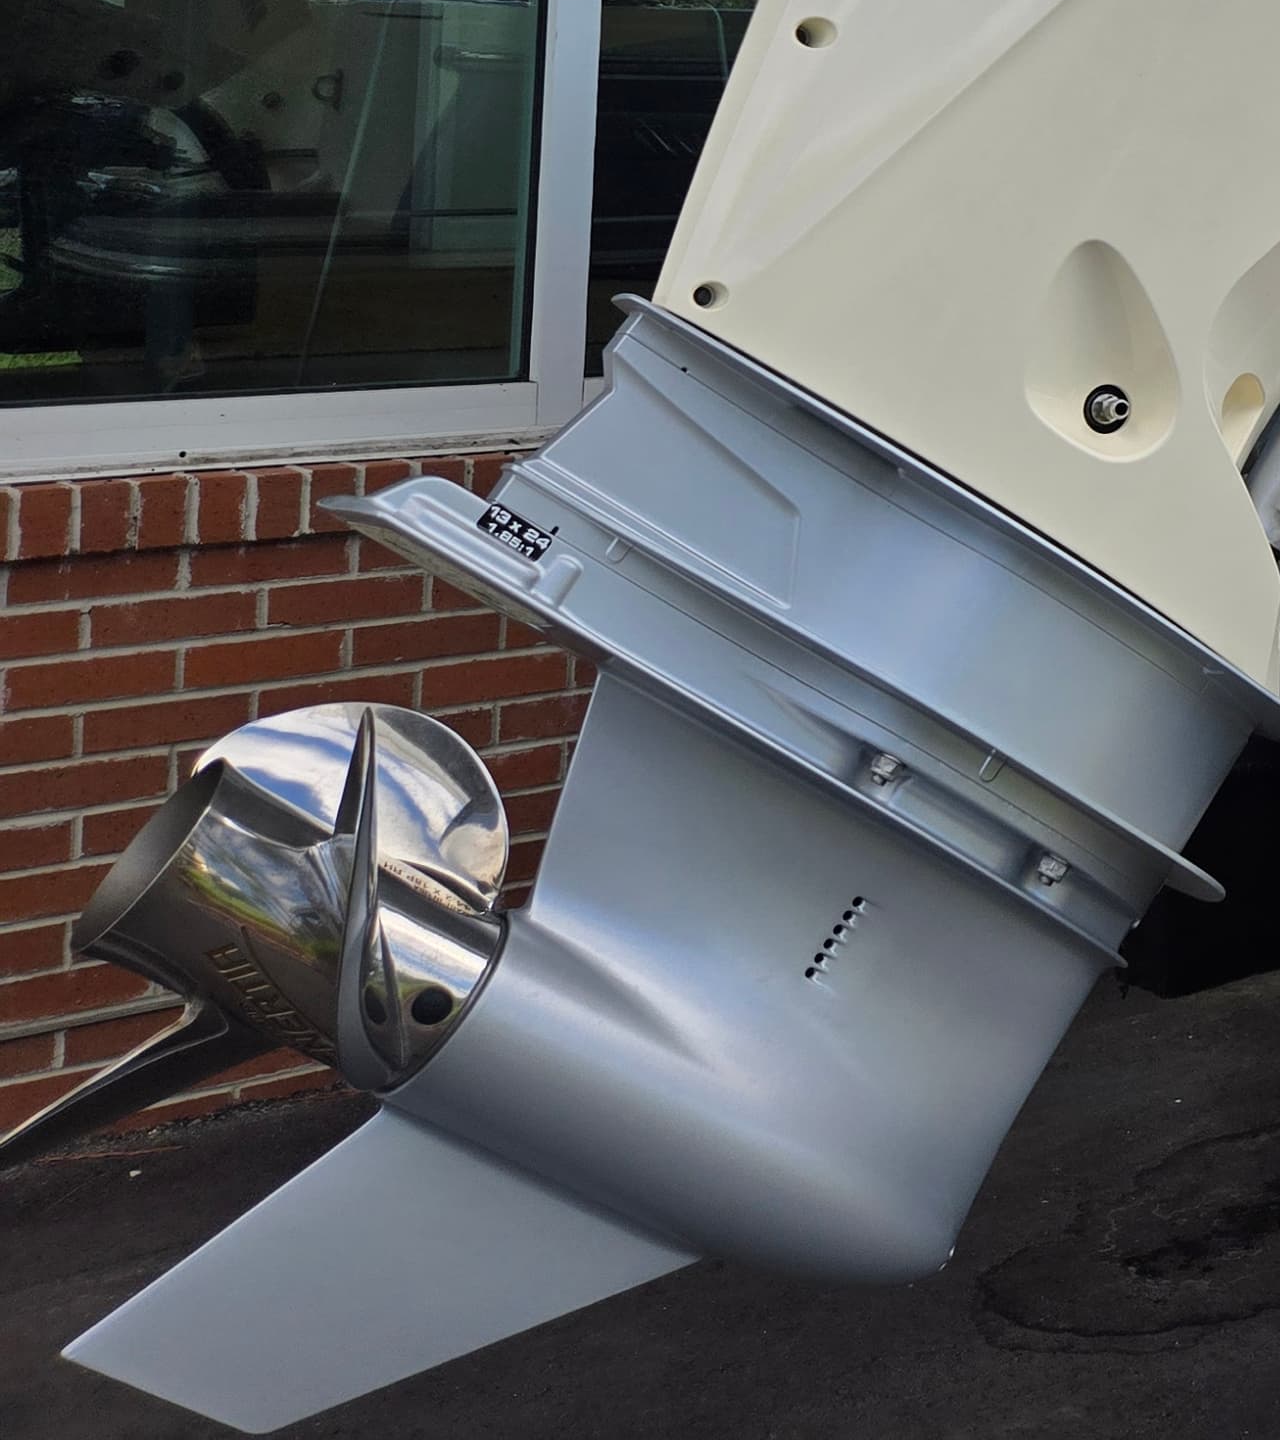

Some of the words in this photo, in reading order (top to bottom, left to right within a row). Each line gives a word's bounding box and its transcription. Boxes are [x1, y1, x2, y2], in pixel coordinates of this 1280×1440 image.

[487, 522, 535, 557] 1.85:1
[490, 506, 512, 526] 13
[509, 521, 522, 533] x
[523, 528, 550, 550] 24
